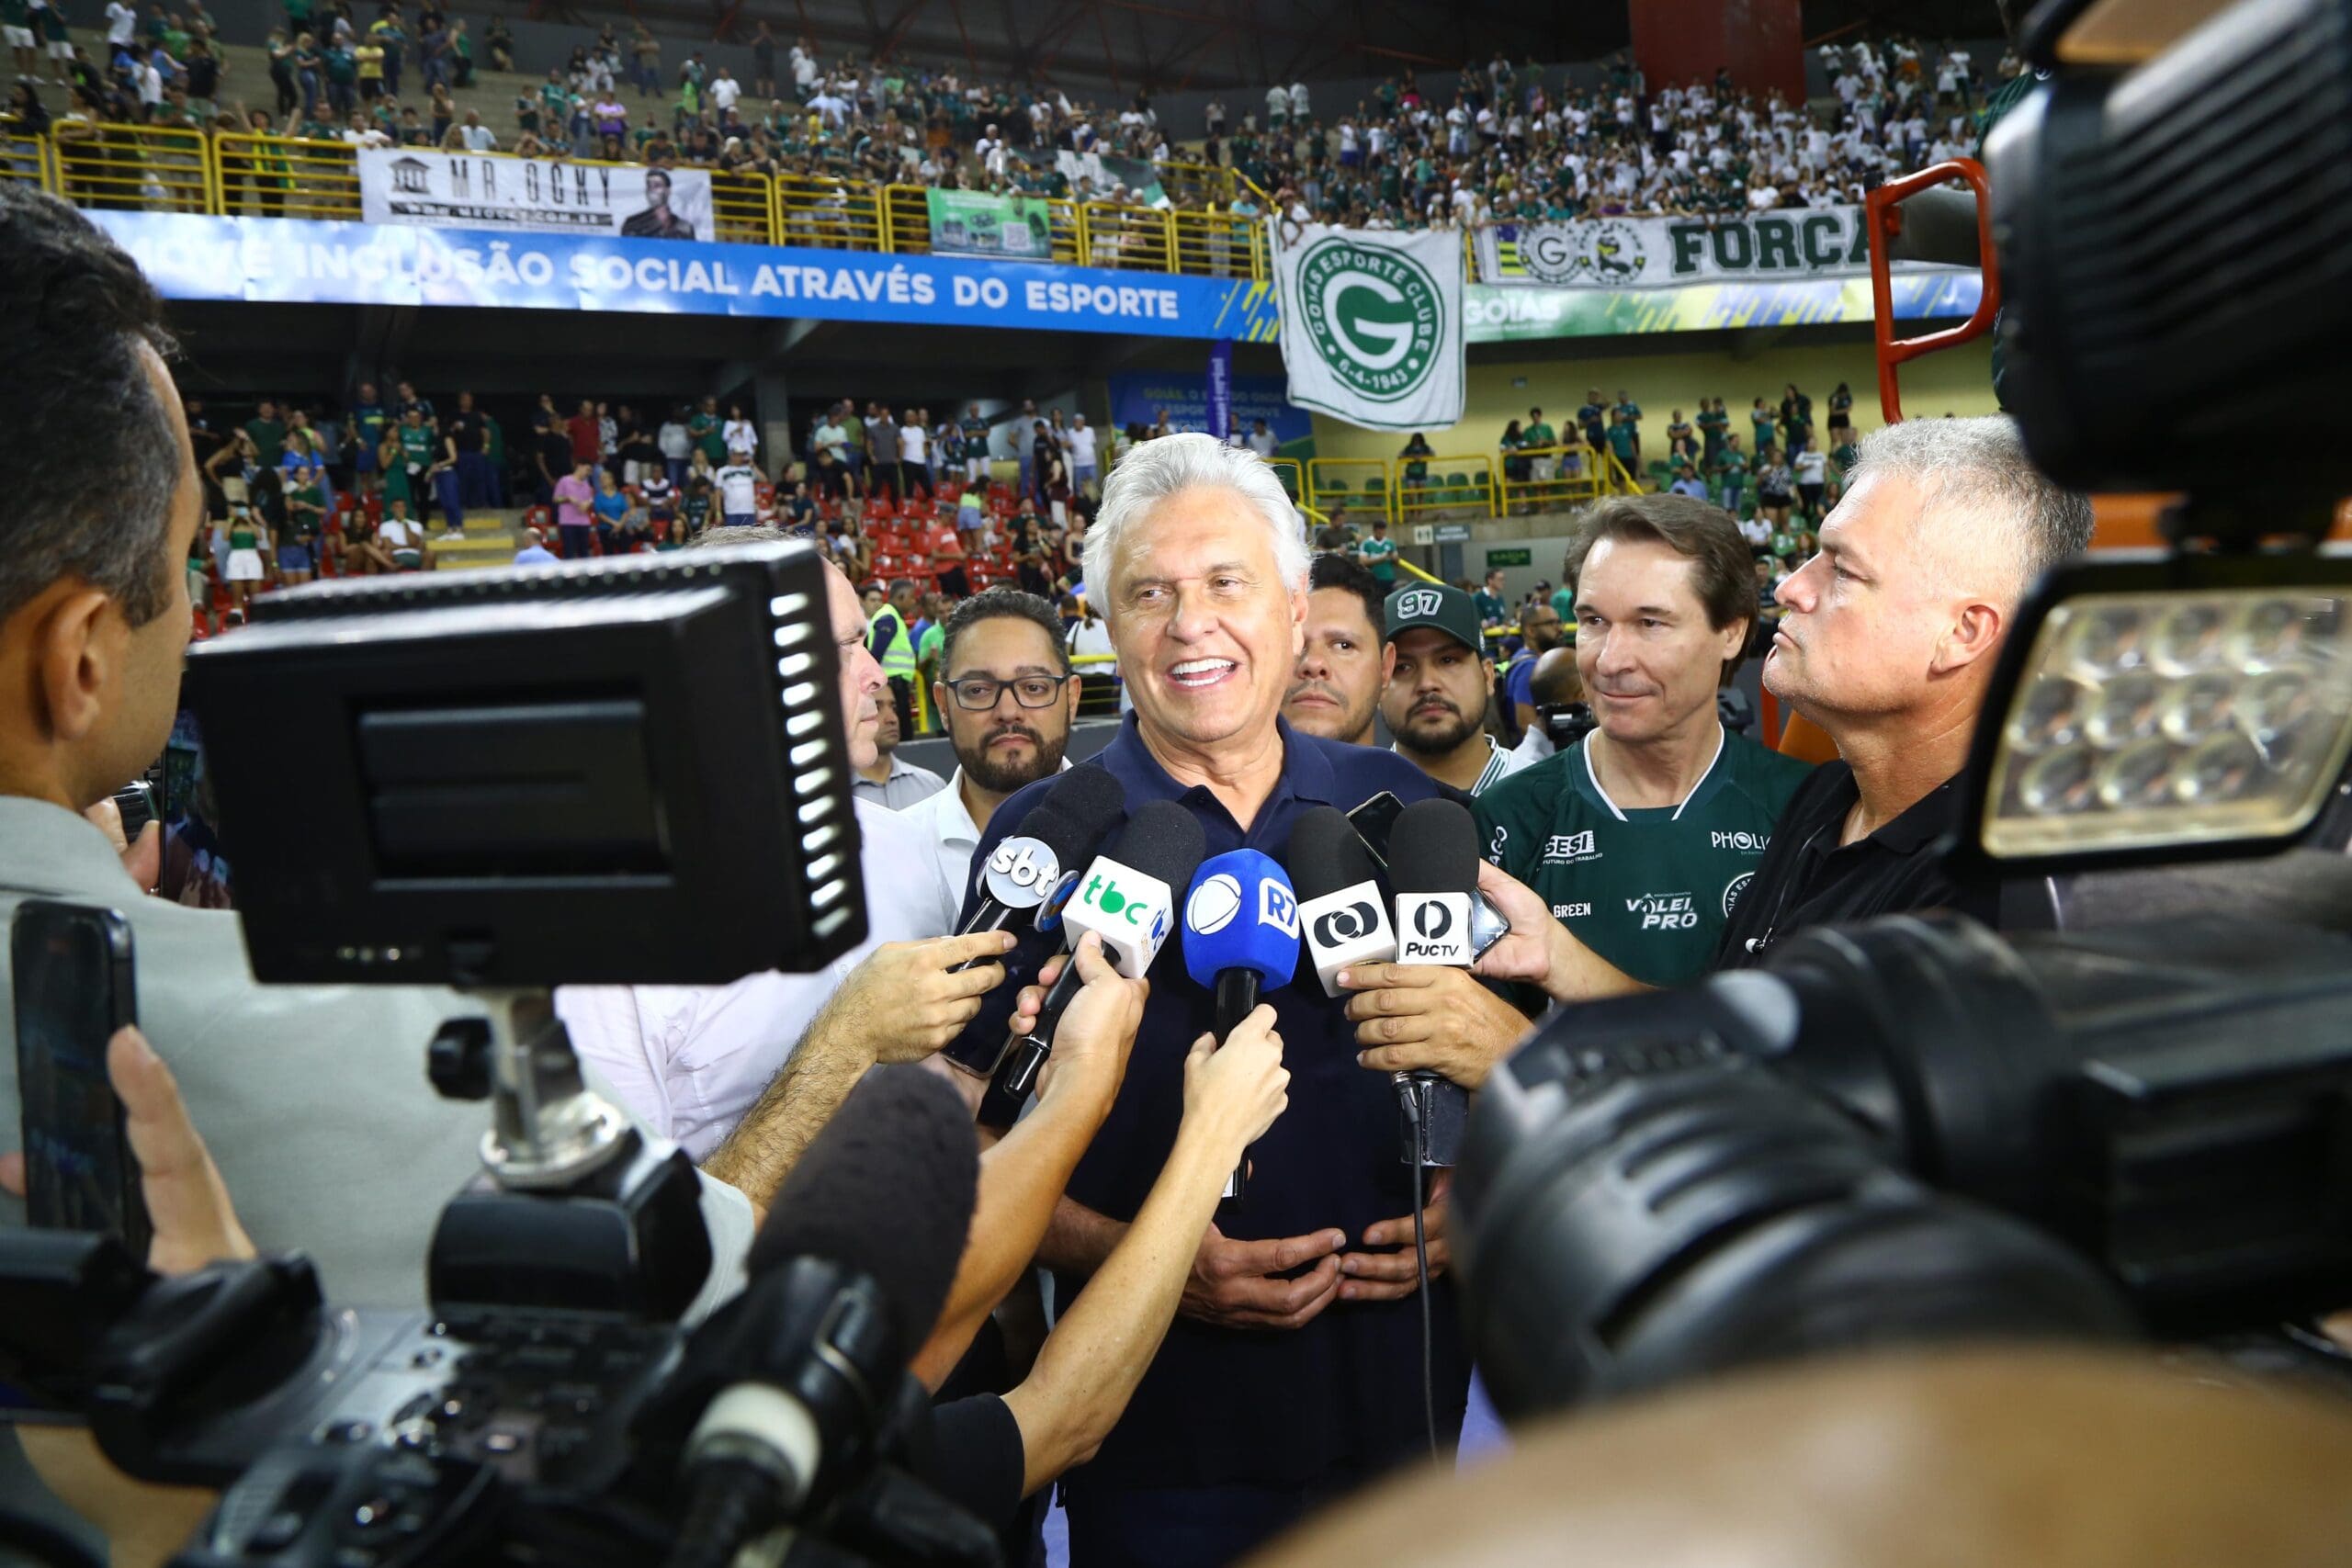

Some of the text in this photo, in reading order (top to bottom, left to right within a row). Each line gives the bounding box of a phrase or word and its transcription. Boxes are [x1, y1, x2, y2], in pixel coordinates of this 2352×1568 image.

[569, 253, 740, 296] SOCIAL
[751, 263, 936, 305] ATRAVÉS
[954, 276, 1009, 309] DO
[1025, 280, 1180, 320] ESPORTE
[1308, 250, 1433, 353] GOIÁS ESPORTE CLUBE
[1338, 358, 1409, 389] 6-4-1943
[1396, 589, 1442, 619] 97
[1544, 832, 1589, 855] SESI
[1711, 830, 1771, 851] PHOLI
[990, 845, 1058, 897] sbt
[1083, 874, 1148, 926] tbc
[1267, 885, 1296, 928] R7
[1553, 902, 1591, 919] GREEN
[1642, 912, 1698, 930] PRO
